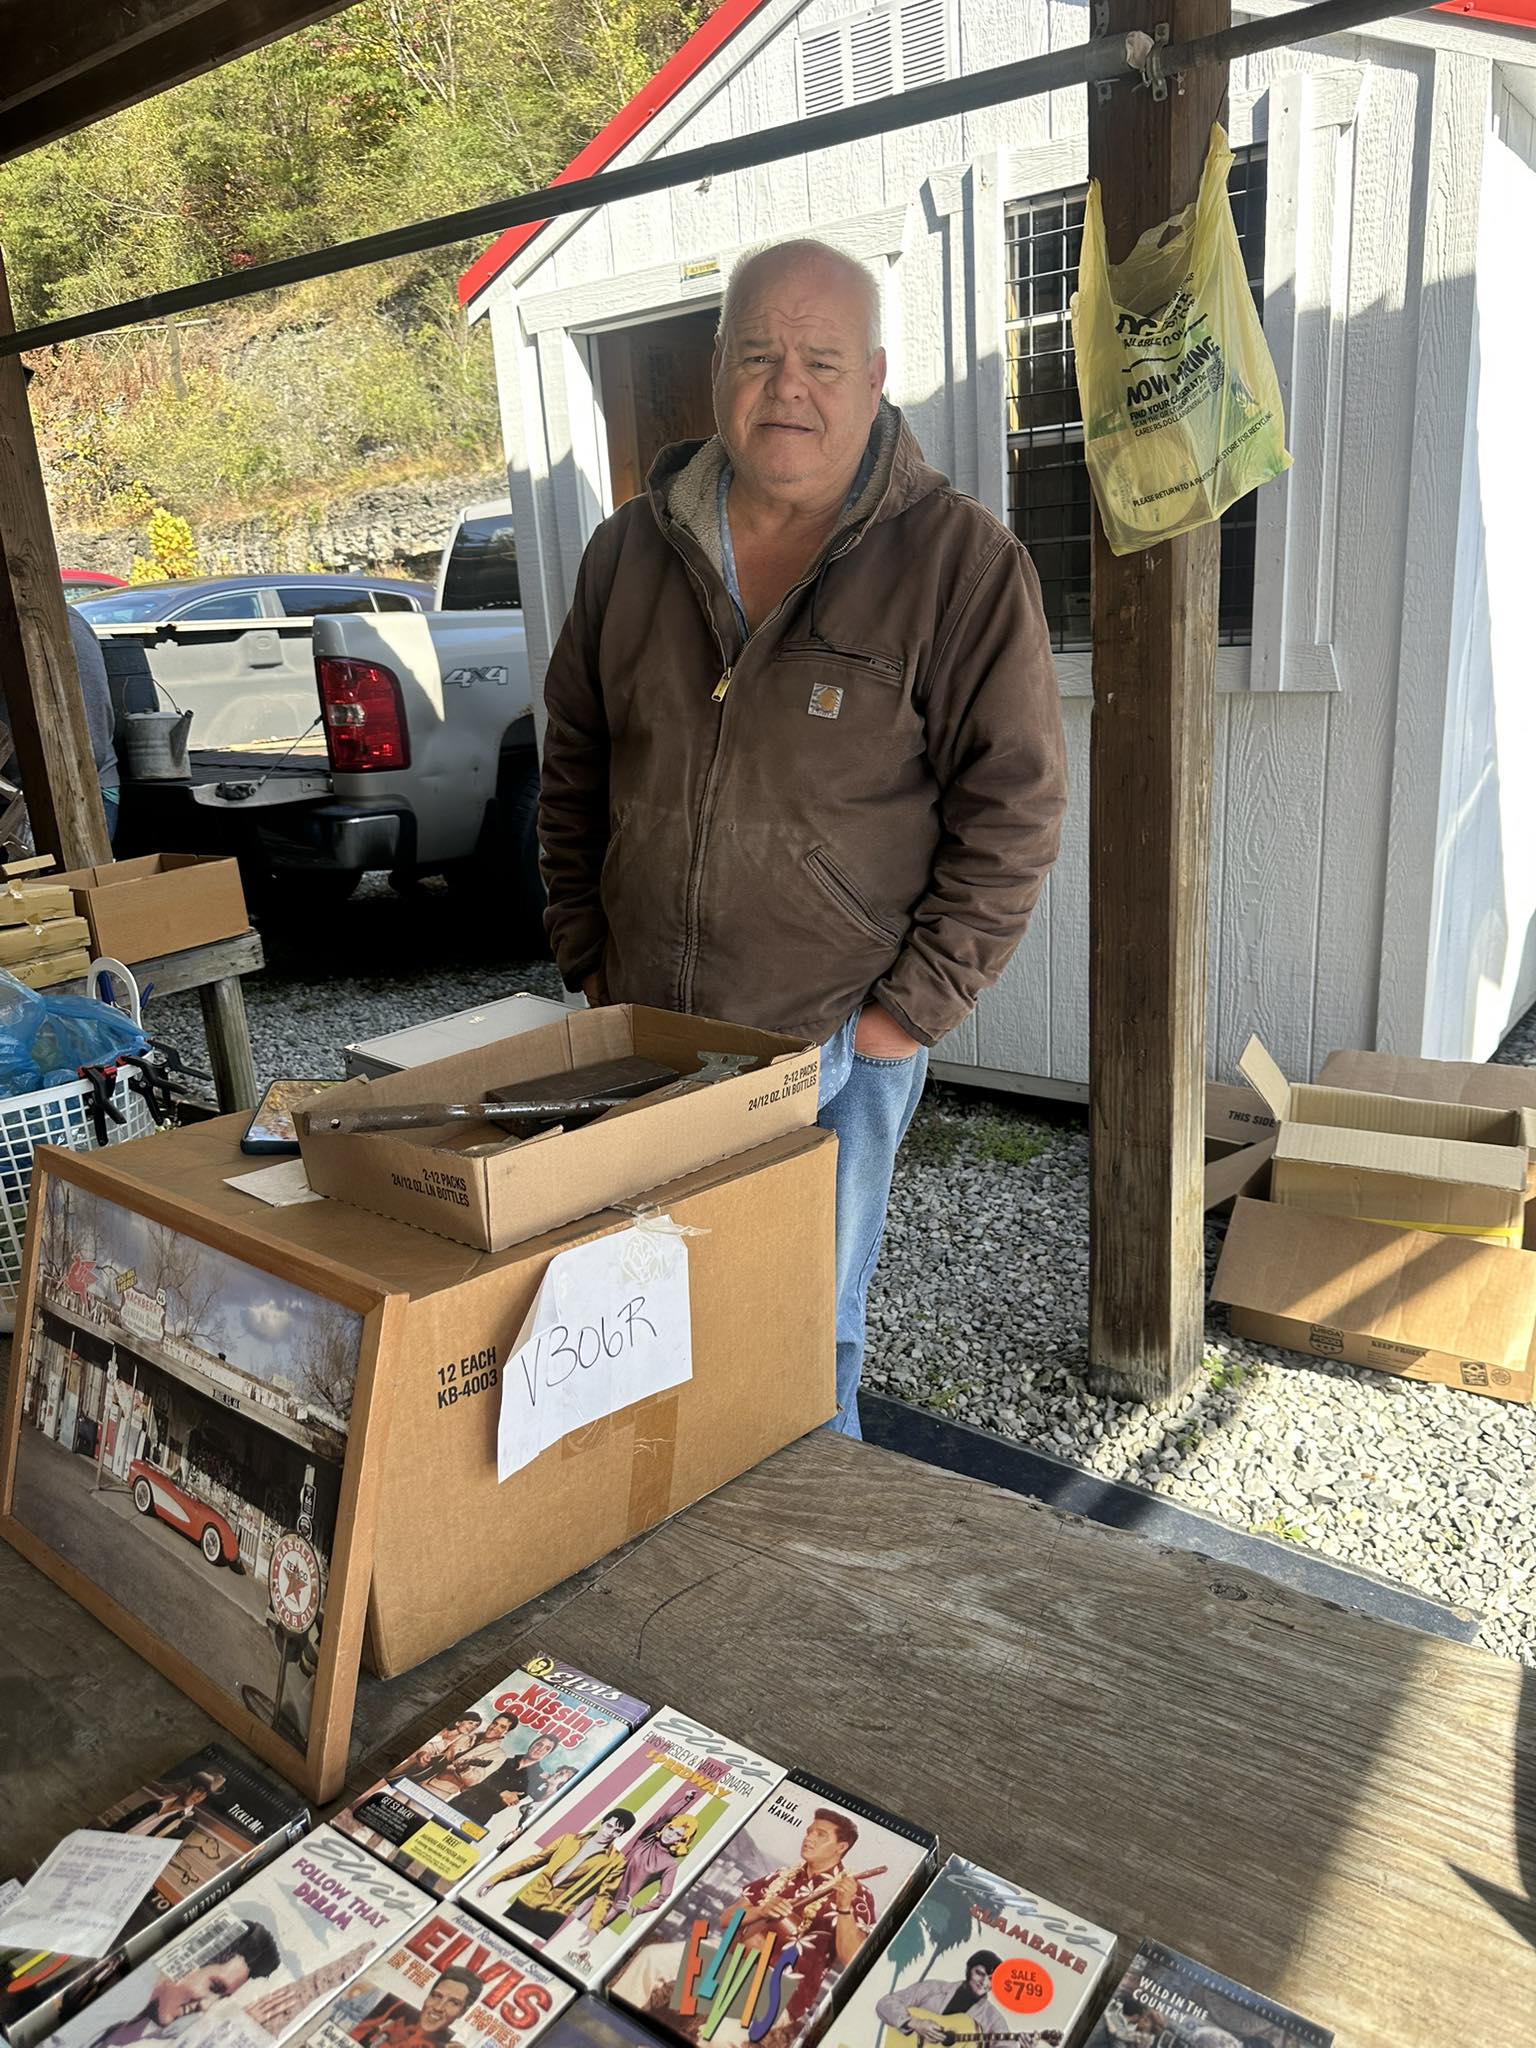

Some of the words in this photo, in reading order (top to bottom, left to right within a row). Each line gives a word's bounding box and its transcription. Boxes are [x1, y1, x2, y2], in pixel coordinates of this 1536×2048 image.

[1127, 374, 1170, 406] NOW
[1130, 410, 1146, 421] FIND
[1147, 399, 1170, 414] YOUR
[1132, 495, 1156, 507] PLEASE
[1155, 485, 1181, 500] RETURN
[1180, 482, 1189, 492] TO
[1222, 441, 1240, 460] STORE
[1238, 433, 1249, 445] FOR
[748, 1094, 770, 1111] 24/12
[781, 1085, 791, 1099] LN
[792, 1074, 817, 1095] BOTTLES
[784, 1070, 799, 1086] 2-12
[799, 1061, 818, 1079] PACKS
[1229, 1110, 1251, 1122] THIS
[1252, 1115, 1276, 1128] SIDE
[392, 1173, 413, 1190] 24/12
[425, 1183, 437, 1197] LN
[436, 1186, 470, 1207] BOTTLES
[422, 1168, 440, 1185] 2-12
[440, 1172, 467, 1191] PACKS
[437, 1363, 457, 1386] 12
[460, 1346, 497, 1378] EACH
[437, 1368, 498, 1409] KB-4003
[275, 1540, 319, 1583] GASOLINE
[287, 1560, 309, 1582] TEXACO
[272, 1577, 298, 1627] MOTOR
[300, 1603, 315, 1625] OIL
[544, 1671, 623, 1701] Elvis
[518, 1683, 608, 1734] Kissin'
[642, 1730, 666, 1751] ELVIS
[661, 1737, 691, 1764] PRESLEY
[689, 1755, 698, 1766] &
[697, 1757, 725, 1779] NANCY
[720, 1772, 755, 1798] SINATRA
[645, 1749, 733, 1800] SPEEDWAY
[228, 1803, 252, 1829] TICKLE
[249, 1820, 265, 1836] ME
[380, 1795, 392, 1806] GET
[397, 1803, 416, 1819] BACK!
[767, 1804, 803, 1829] HAWAII
[775, 1795, 799, 1812] BLUE
[291, 1856, 352, 1901] FOLLOW
[348, 1895, 391, 1929] THAT
[292, 1881, 353, 1932] DREAM
[969, 1903, 1088, 1976] CLAMBAKE
[386, 1949, 410, 1970] IN
[402, 1958, 437, 1990] THE
[404, 1914, 554, 2031] ELVIS
[678, 1906, 800, 2044] ELVIS
[1010, 1968, 1037, 1982] SALE
[1132, 1989, 1187, 2024] COUNTRY
[1139, 1975, 1170, 2000] WILD
[1170, 1992, 1185, 2009] IN
[1185, 2002, 1210, 2021] THE
[464, 2005, 523, 2048] MOVIES
